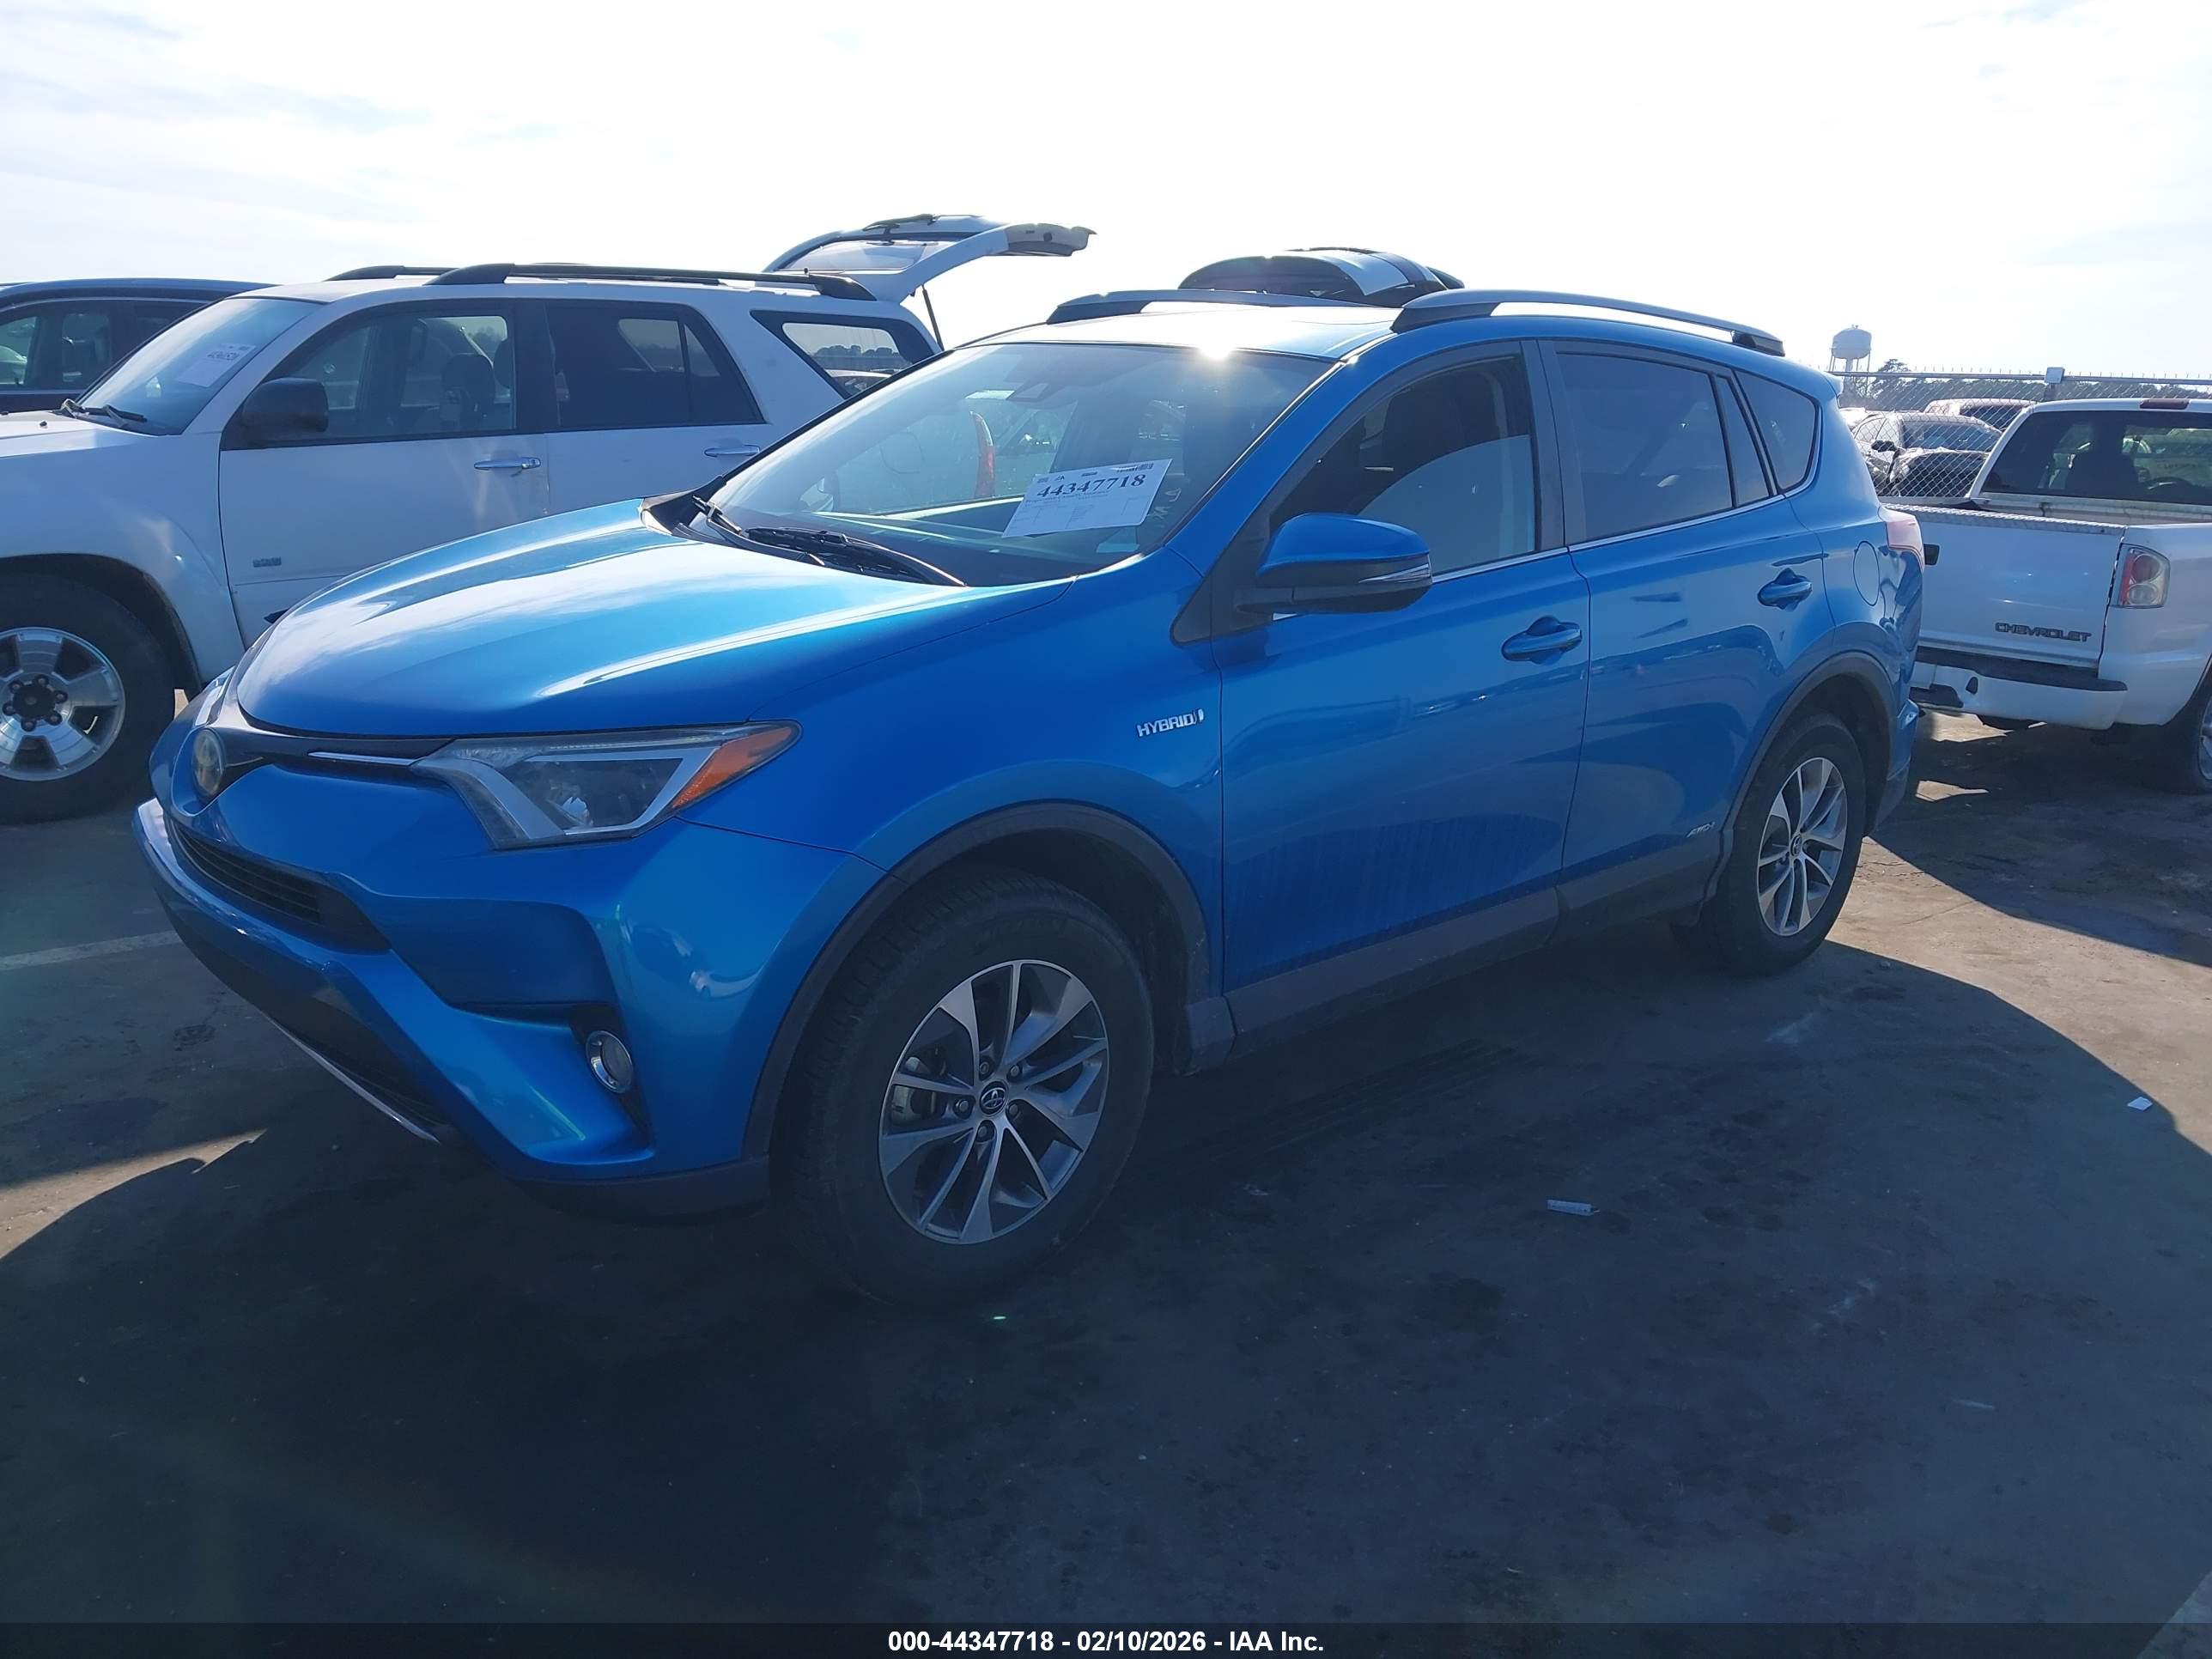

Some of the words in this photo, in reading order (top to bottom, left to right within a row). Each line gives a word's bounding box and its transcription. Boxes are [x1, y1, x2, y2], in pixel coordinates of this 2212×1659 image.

[1036, 473, 1146, 498] 44347718
[1995, 623, 2092, 642] CHEVROLET
[1136, 714, 1197, 737] HYBRID
